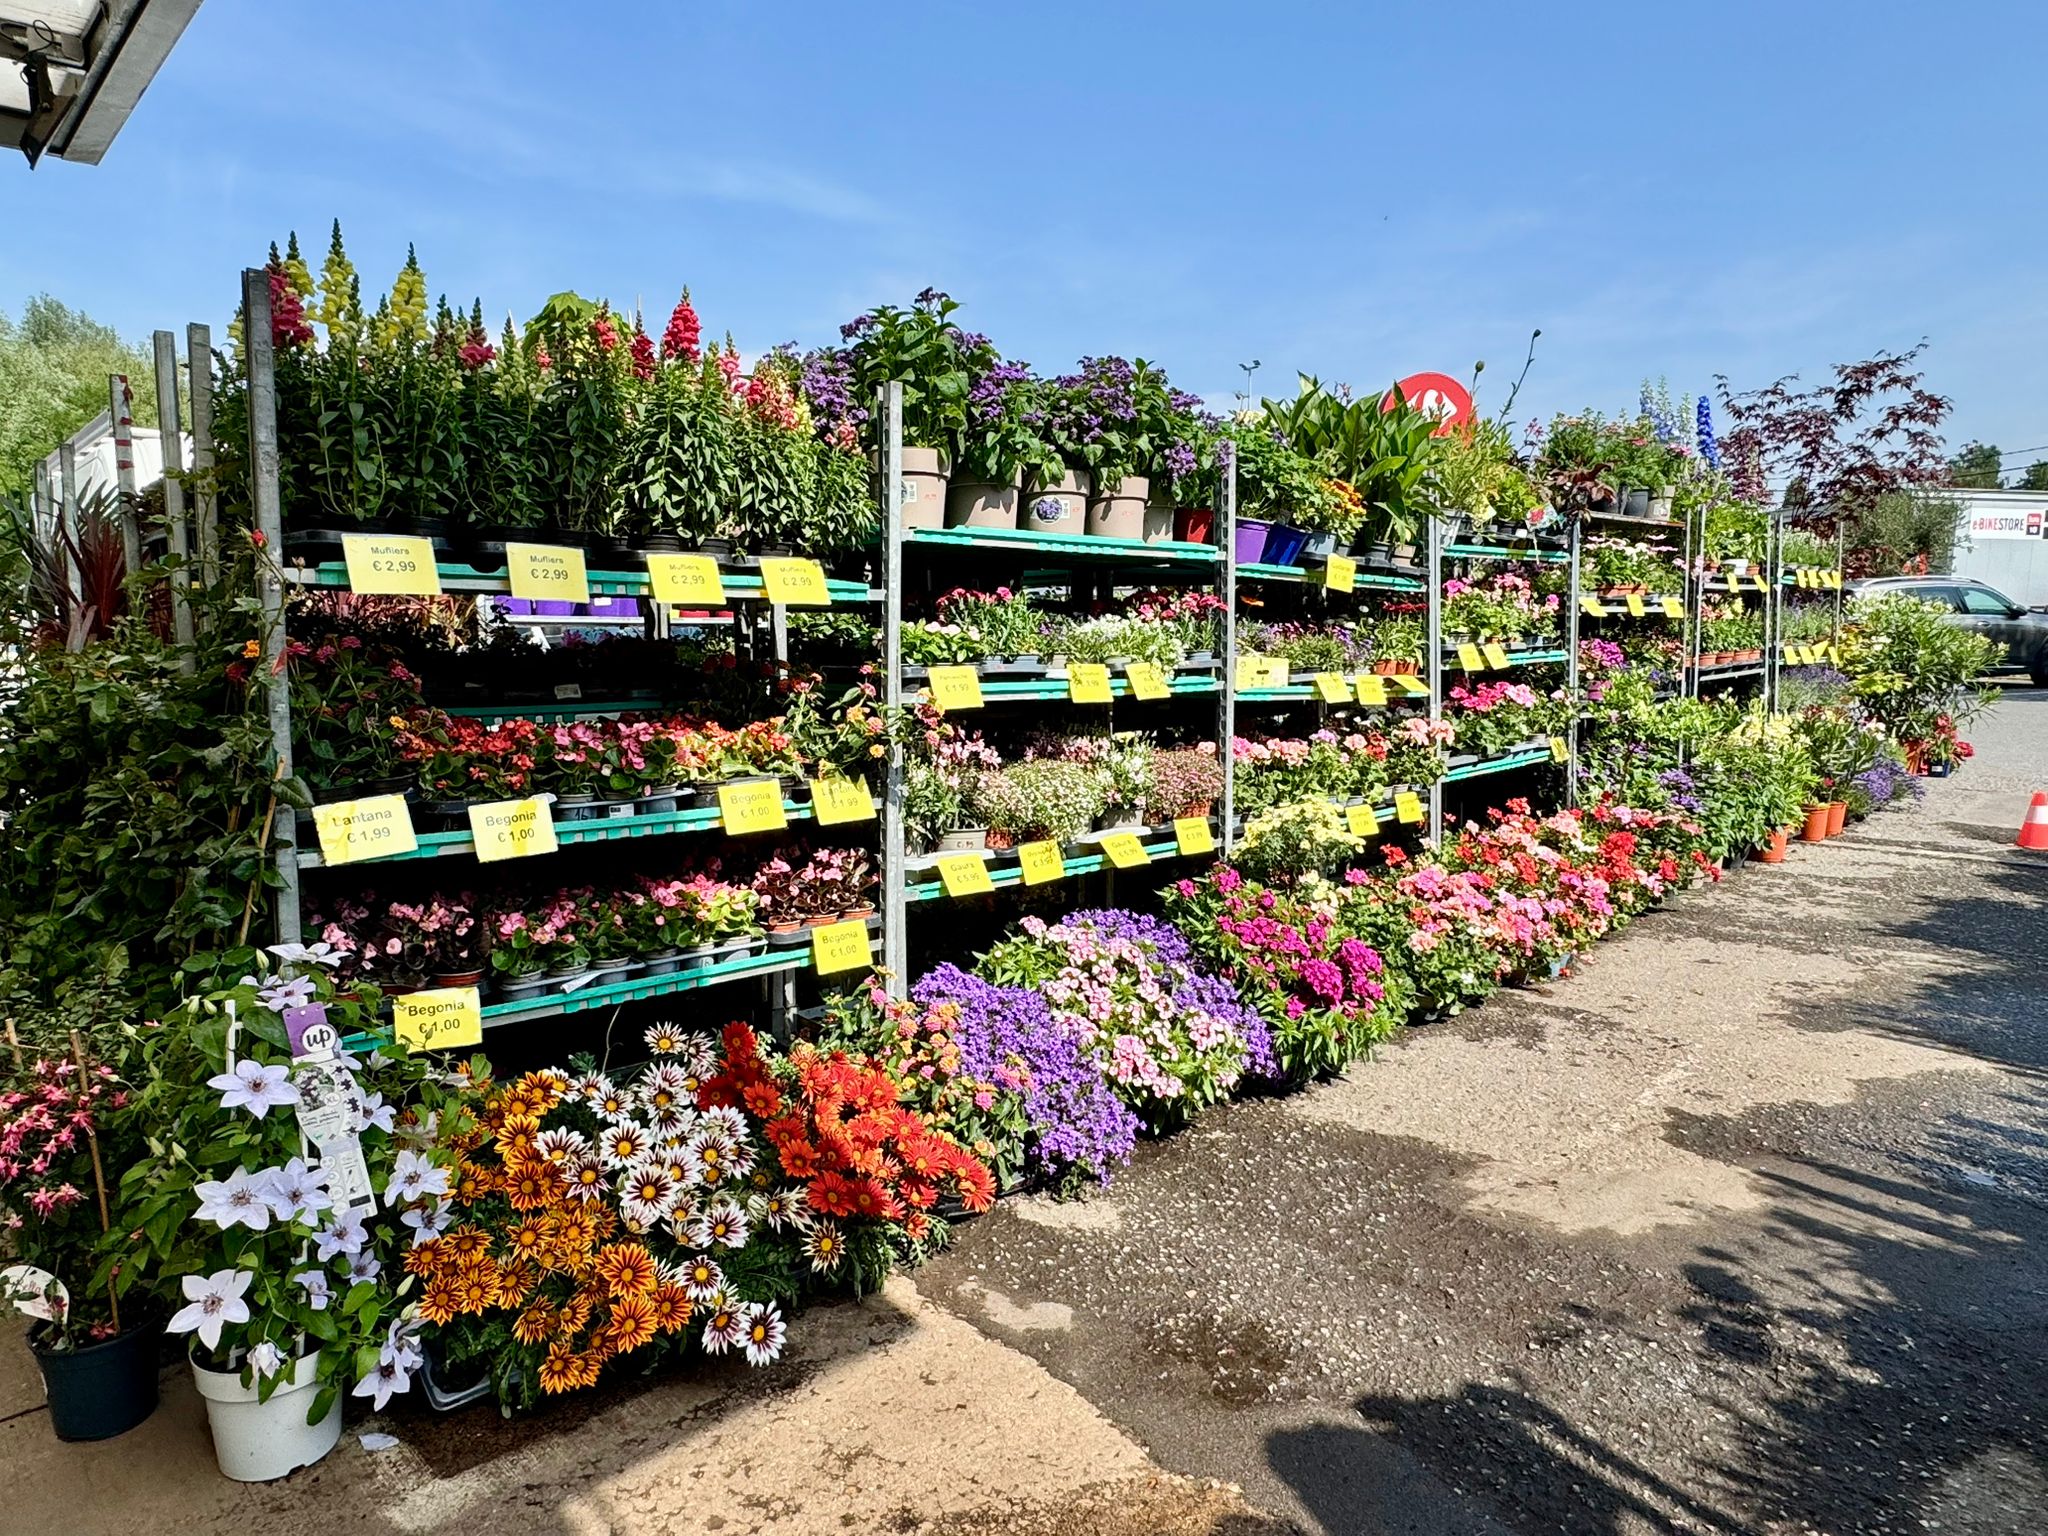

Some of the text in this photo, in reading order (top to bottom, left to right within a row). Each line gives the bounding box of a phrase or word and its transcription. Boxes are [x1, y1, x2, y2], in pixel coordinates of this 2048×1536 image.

[370, 546, 410, 555] Mufliers
[372, 560, 416, 573] € 2,99
[531, 568, 569, 580] € 2,99
[671, 574, 705, 585] € 2,99
[791, 576, 812, 587] 2,99
[730, 792, 771, 805] Begonia
[332, 810, 393, 827] Lantana
[485, 810, 537, 827] Begonia
[740, 806, 770, 818] € 1,00
[347, 826, 391, 843] € 1,99
[497, 827, 535, 843] € 1,00
[822, 930, 858, 944] Begonia
[830, 944, 857, 958] € 1,00
[408, 999, 465, 1016] Begonia
[418, 1018, 461, 1034] € 1,00
[306, 1028, 331, 1048] up
